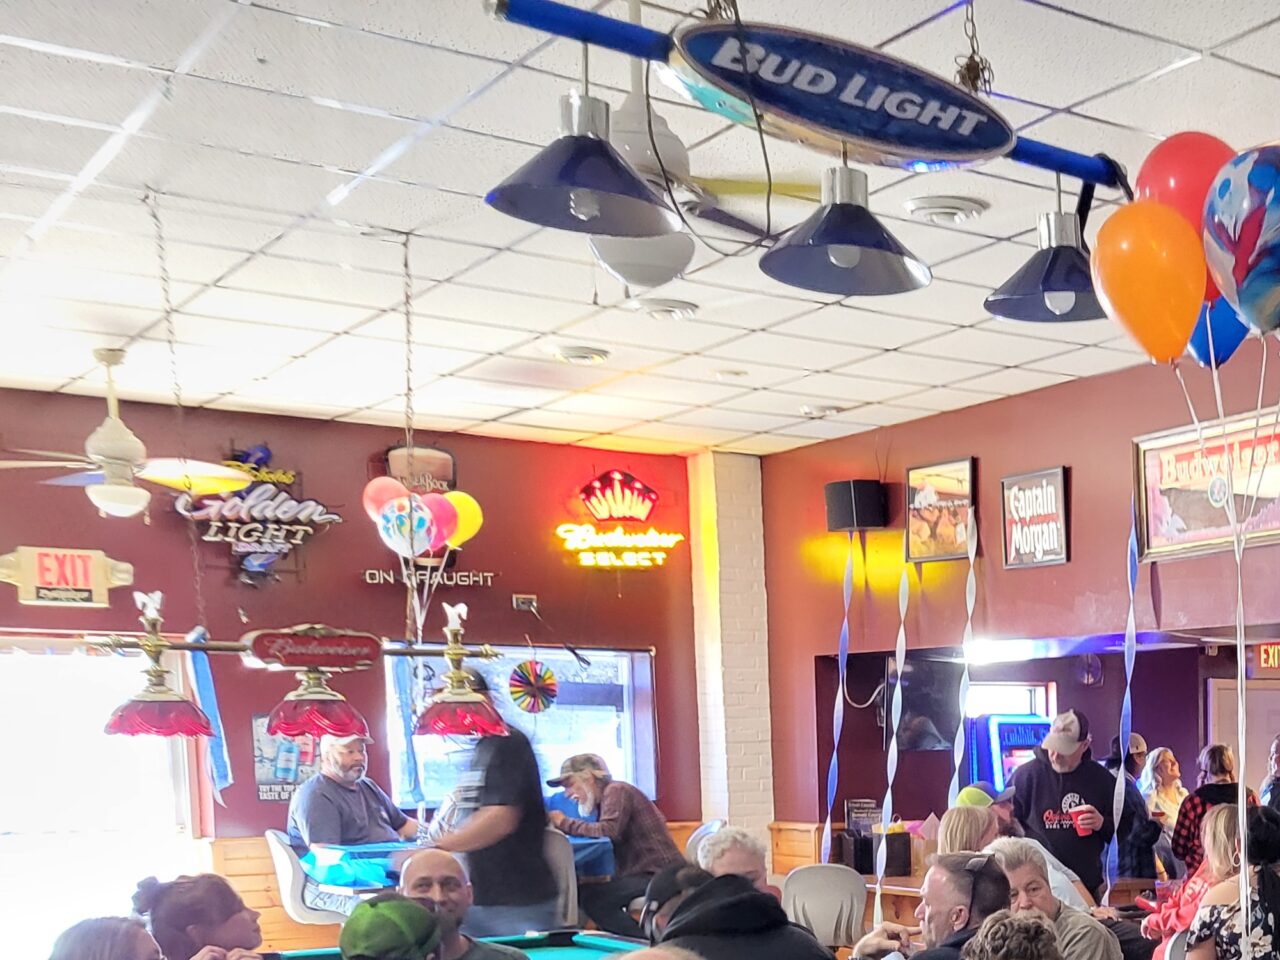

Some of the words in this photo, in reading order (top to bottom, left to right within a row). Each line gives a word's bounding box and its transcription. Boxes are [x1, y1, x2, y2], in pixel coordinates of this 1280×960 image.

[711, 37, 837, 95] BUD
[838, 73, 988, 137] LIGHT
[1160, 440, 1280, 485] Budweiser
[1009, 479, 1056, 524] Captain
[202, 521, 313, 544] LIGHT
[556, 523, 685, 550] Budweiser
[1009, 520, 1058, 562] Morgan
[36, 552, 92, 588] EXIT
[578, 551, 667, 566] SELECT
[365, 569, 394, 584] ON
[264, 637, 371, 657] Budweiser
[258, 792, 280, 800] TASTE
[281, 792, 290, 800] OF
